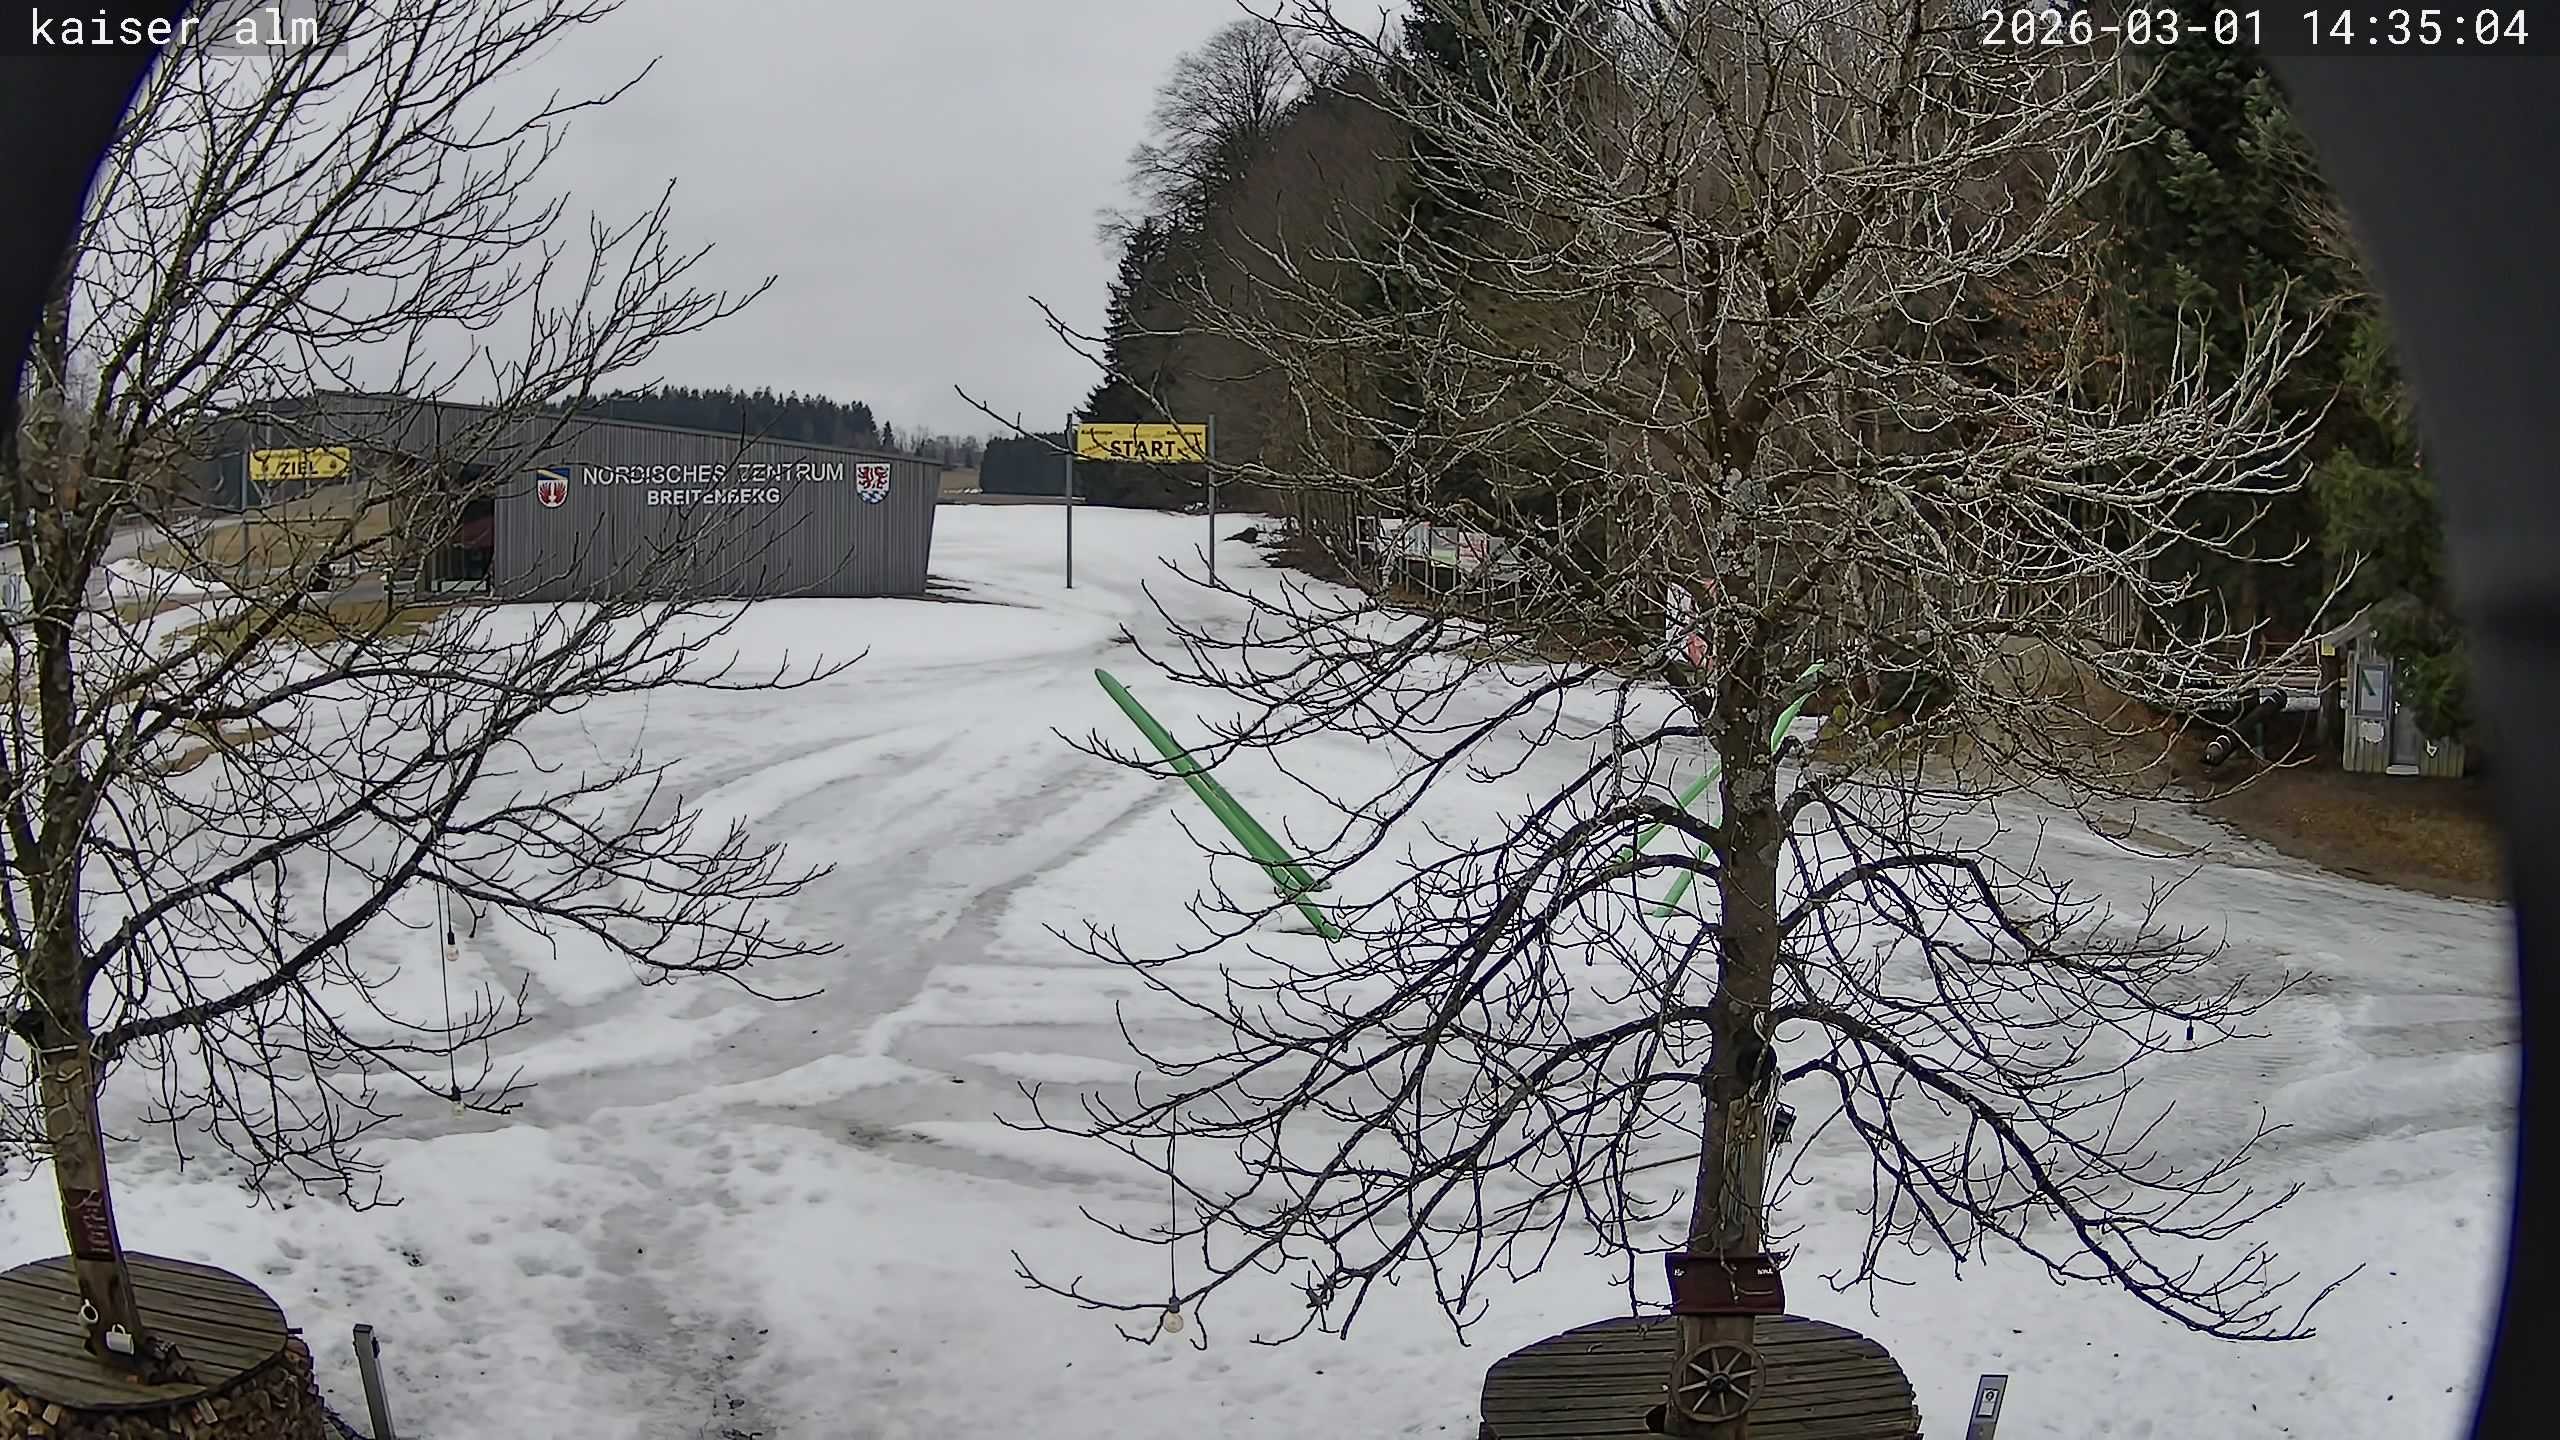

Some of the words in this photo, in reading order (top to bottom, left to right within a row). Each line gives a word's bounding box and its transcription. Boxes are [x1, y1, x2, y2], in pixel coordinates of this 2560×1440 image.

[1110, 440, 1176, 457] START
[279, 461, 318, 476] ZIEL
[583, 463, 727, 486] NORDISCHES
[738, 462, 844, 484] ZENTRUM
[647, 487, 781, 506] BREITENBERG
